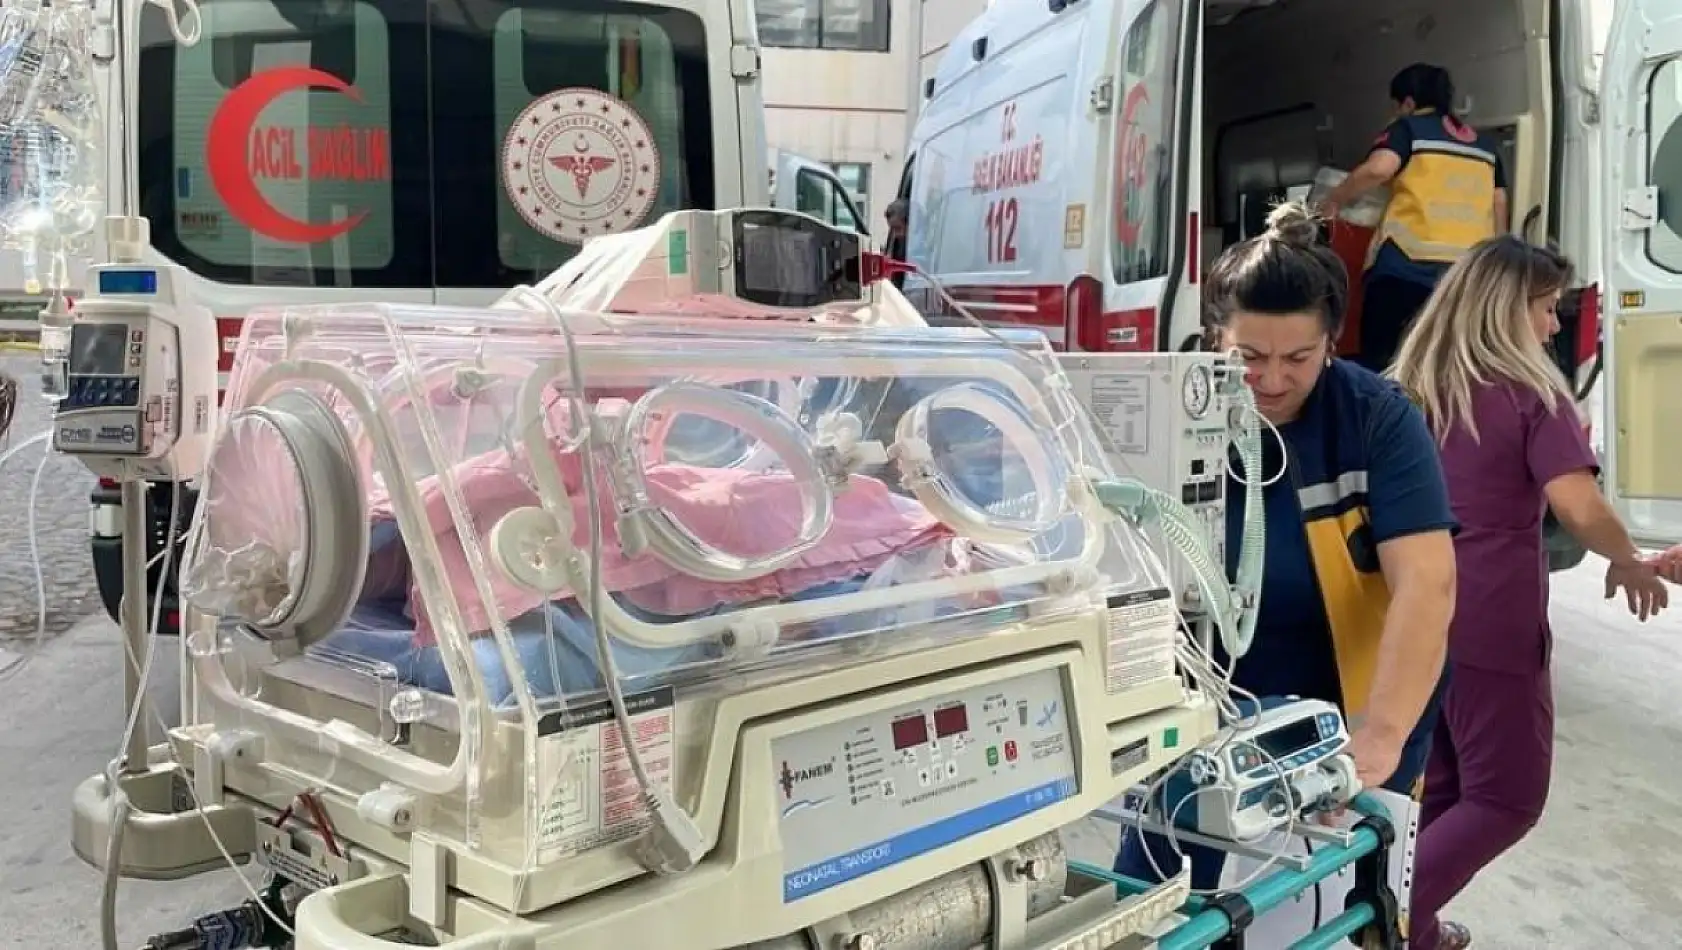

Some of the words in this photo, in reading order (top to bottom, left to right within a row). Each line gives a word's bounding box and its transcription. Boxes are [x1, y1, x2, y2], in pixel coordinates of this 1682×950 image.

[985, 197, 1018, 264] 112
[793, 762, 834, 783] FANEM
[786, 861, 840, 892] NEONATAL
